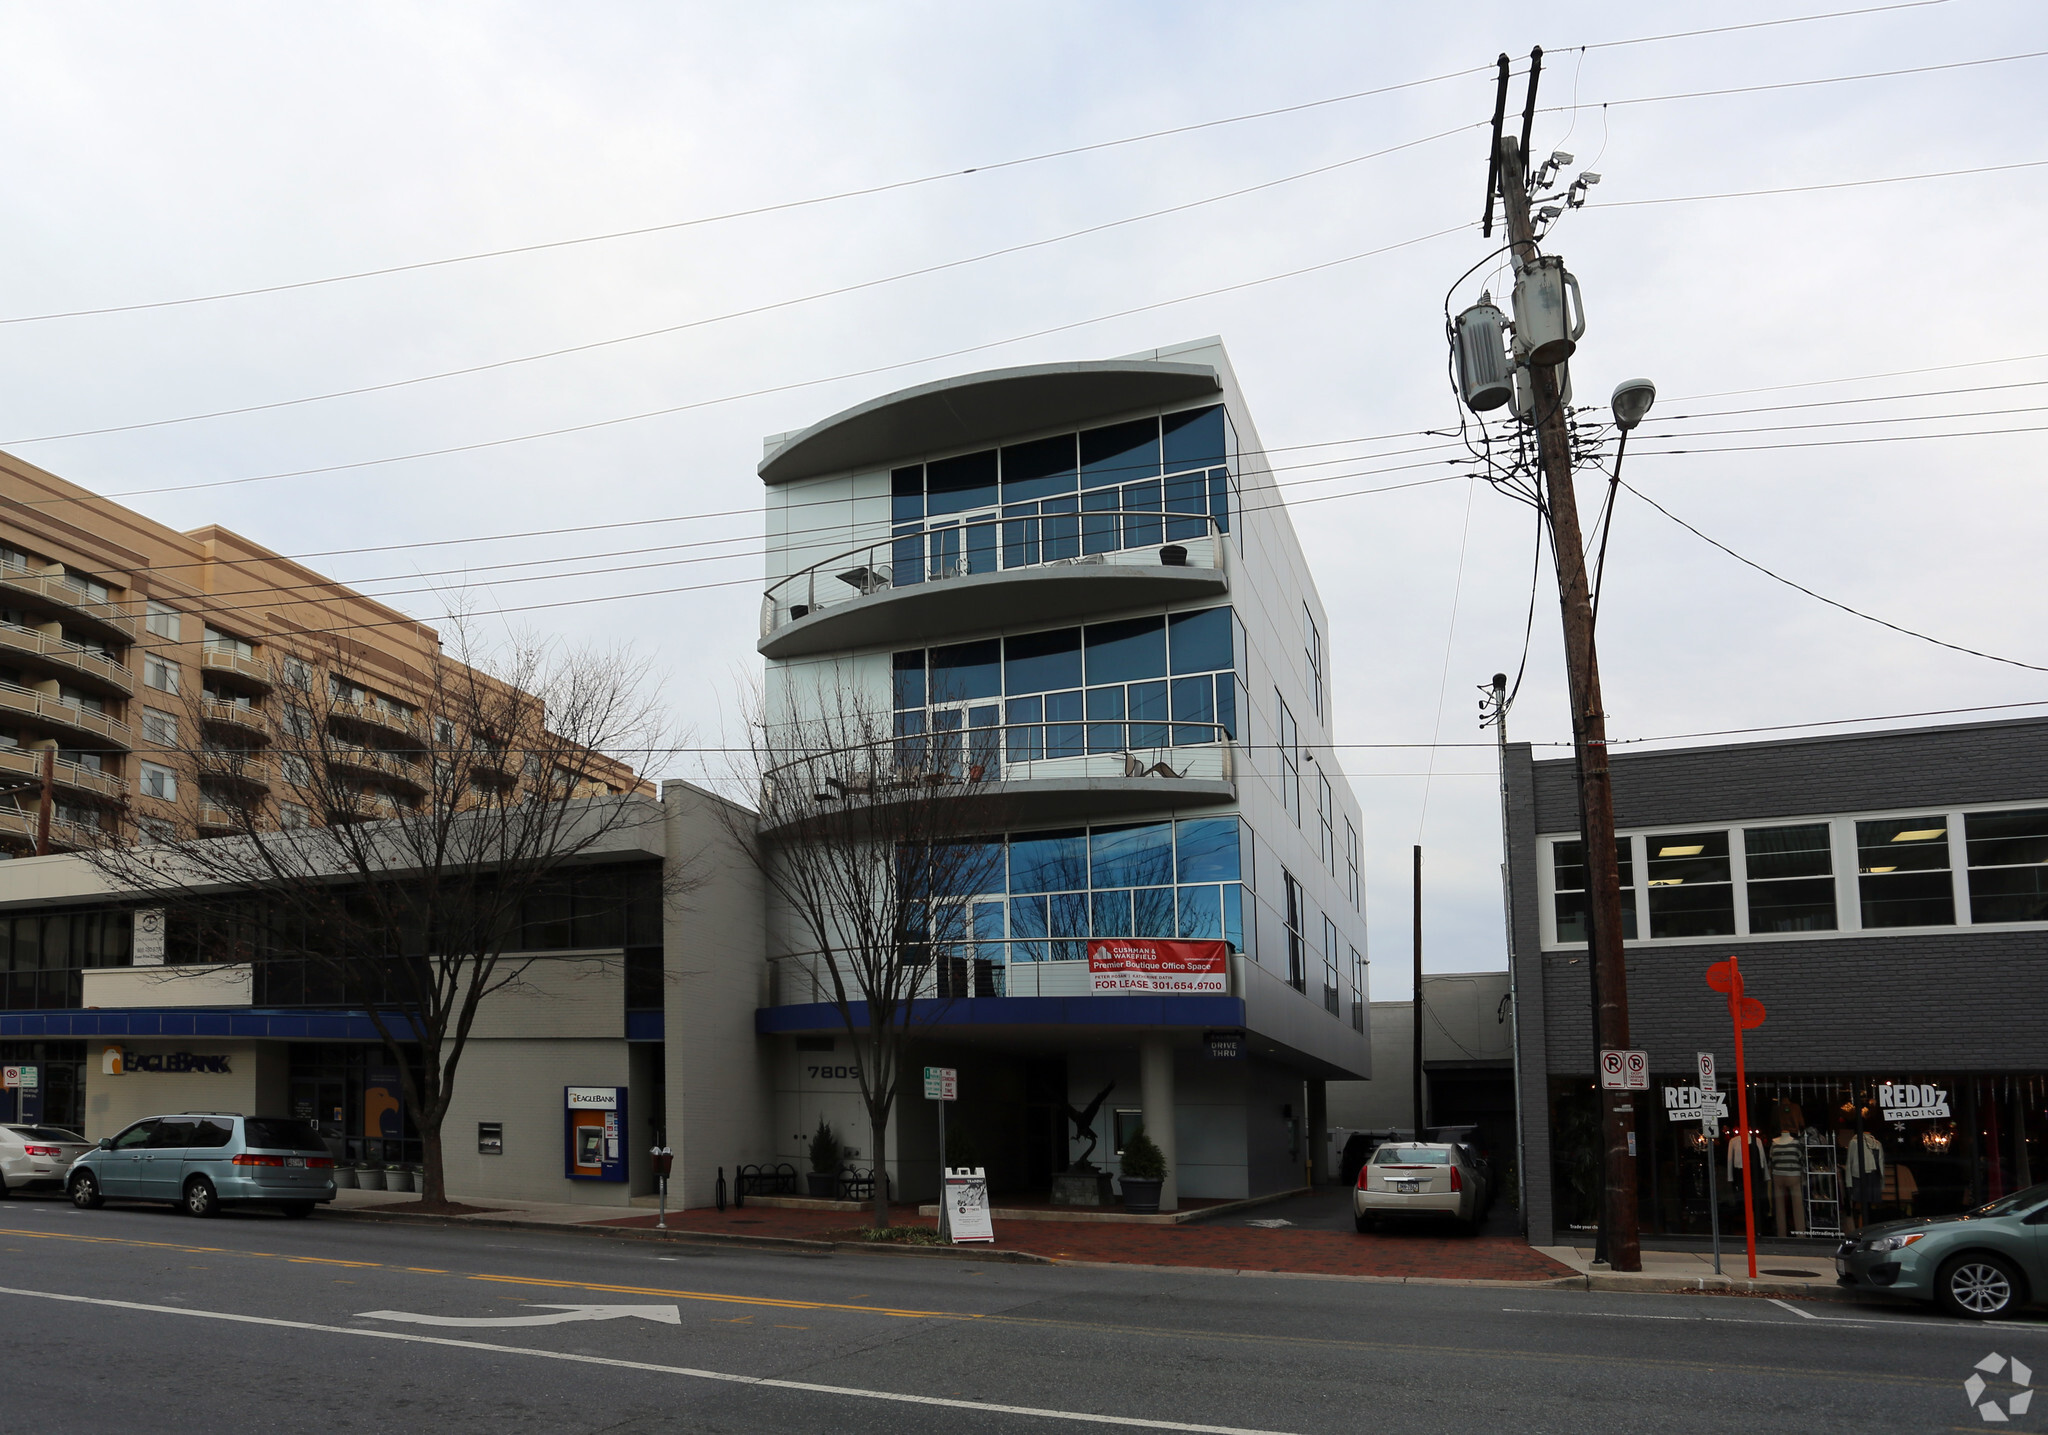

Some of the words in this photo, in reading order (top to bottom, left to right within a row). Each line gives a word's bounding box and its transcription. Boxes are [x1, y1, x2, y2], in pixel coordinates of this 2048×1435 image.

[1093, 961, 1124, 969] Premier
[1125, 961, 1160, 970] Boutique
[1187, 963, 1211, 971] Space
[1095, 981, 1117, 989] FOR
[1119, 980, 1149, 989] LEASE
[1152, 981, 1222, 990] 301.654.9700
[808, 1066, 859, 1079] 7809
[1673, 1110, 1722, 1118] TRADG
[1888, 1109, 1943, 1119] TRADING
